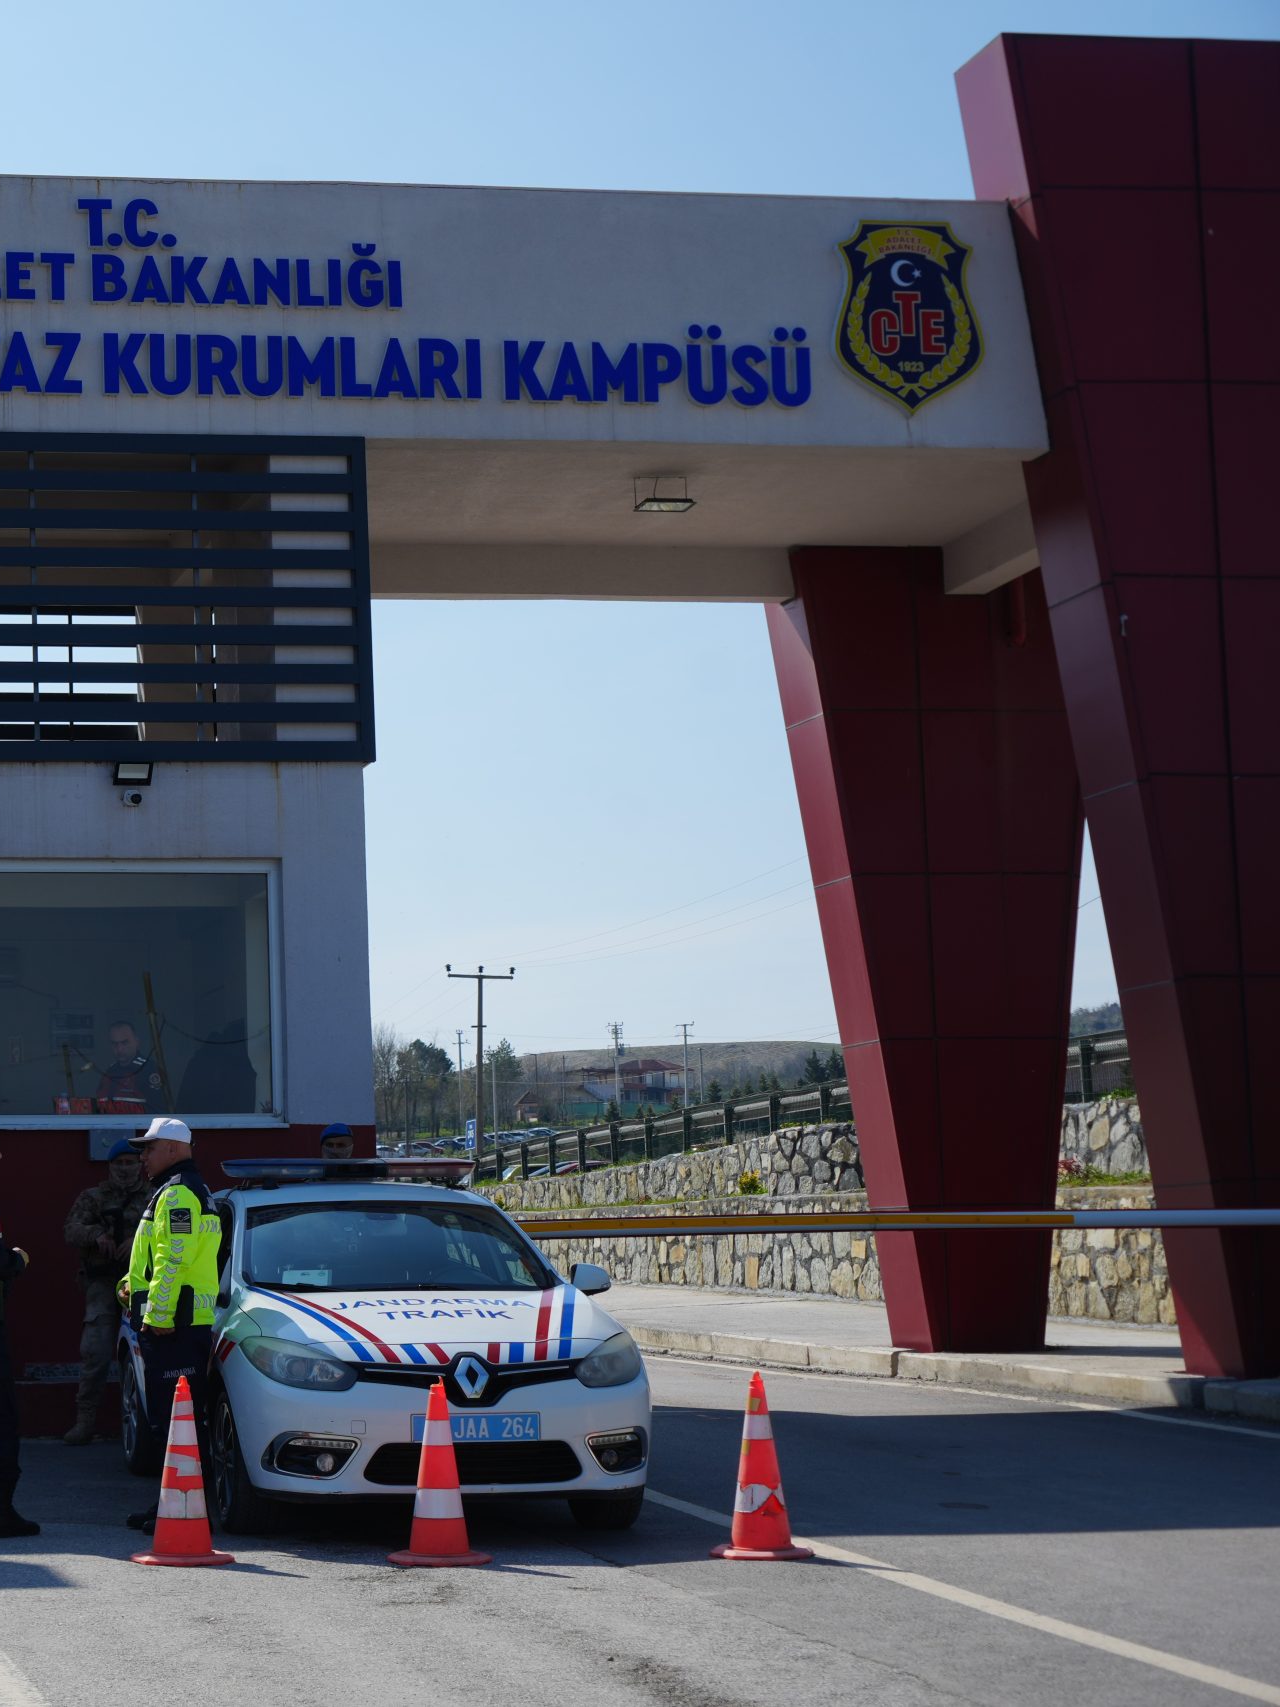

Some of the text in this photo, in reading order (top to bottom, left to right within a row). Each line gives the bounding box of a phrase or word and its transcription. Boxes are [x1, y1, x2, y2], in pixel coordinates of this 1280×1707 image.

[78, 198, 177, 248] T.C.
[91, 243, 403, 309] BAKANLIĞI
[869, 291, 947, 356] CTE
[102, 332, 483, 400] KURUMLARI
[503, 324, 812, 408] KAMPÜSÜ
[898, 361, 925, 373] 1923
[331, 1298, 536, 1311] JANDARMA
[378, 1308, 514, 1321] TRAFİK
[454, 1416, 536, 1439] JAA 264
